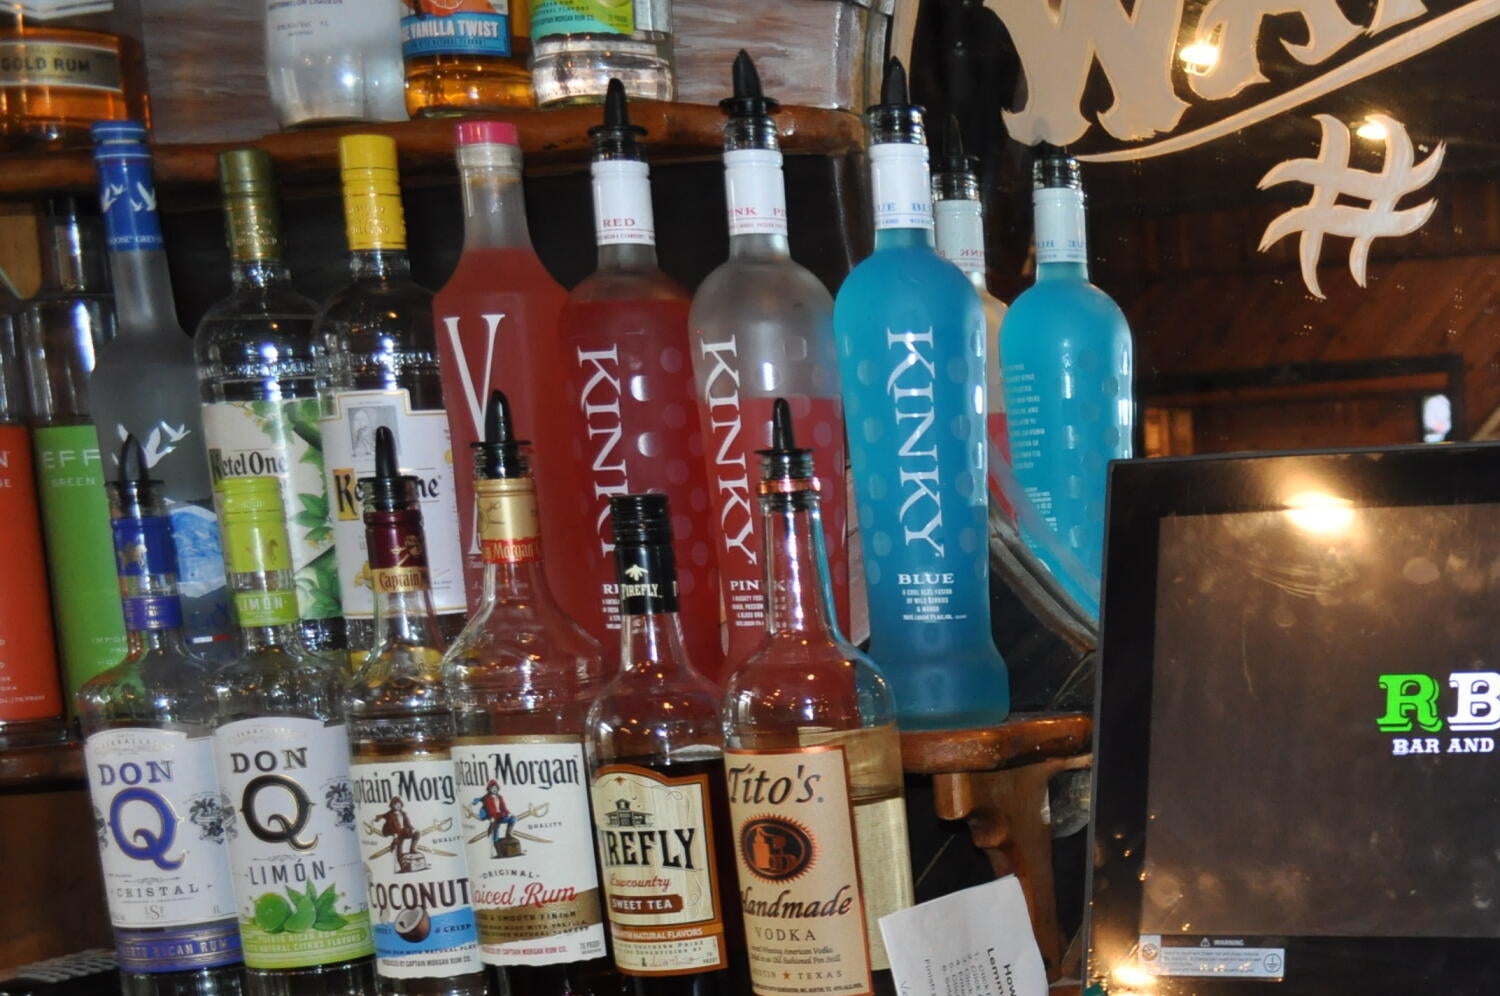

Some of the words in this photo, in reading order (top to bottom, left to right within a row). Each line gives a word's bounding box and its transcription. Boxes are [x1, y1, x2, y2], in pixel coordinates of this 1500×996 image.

[410, 19, 455, 38] VANILLA
[457, 19, 499, 38] TWIST
[54, 57, 91, 74] RUM
[602, 218, 636, 227] RED
[700, 334, 758, 566] KINKY
[887, 325, 945, 558] KINKY
[249, 450, 288, 476] One
[51, 477, 97, 488] GREEN
[493, 542, 534, 562] Morgan
[897, 573, 955, 585] BLUE
[622, 583, 659, 600] FIREFLY
[1392, 737, 1441, 755] BAR
[1447, 737, 1495, 753] AND
[230, 747, 308, 774] DON
[97, 759, 175, 786] DON
[488, 753, 580, 790] Morgan
[240, 774, 319, 852] Q
[109, 786, 187, 871] Q
[249, 857, 327, 886] LIMÓN
[116, 883, 200, 899] CRISTAL
[369, 877, 470, 912] COCONUT
[520, 881, 577, 909] Rum
[612, 898, 643, 911] SWEET
[646, 898, 673, 910] TEA
[667, 927, 704, 939] FLAVORS
[754, 927, 817, 942] VODKA
[200, 935, 228, 952] RUM
[797, 970, 843, 980] TEXAS
